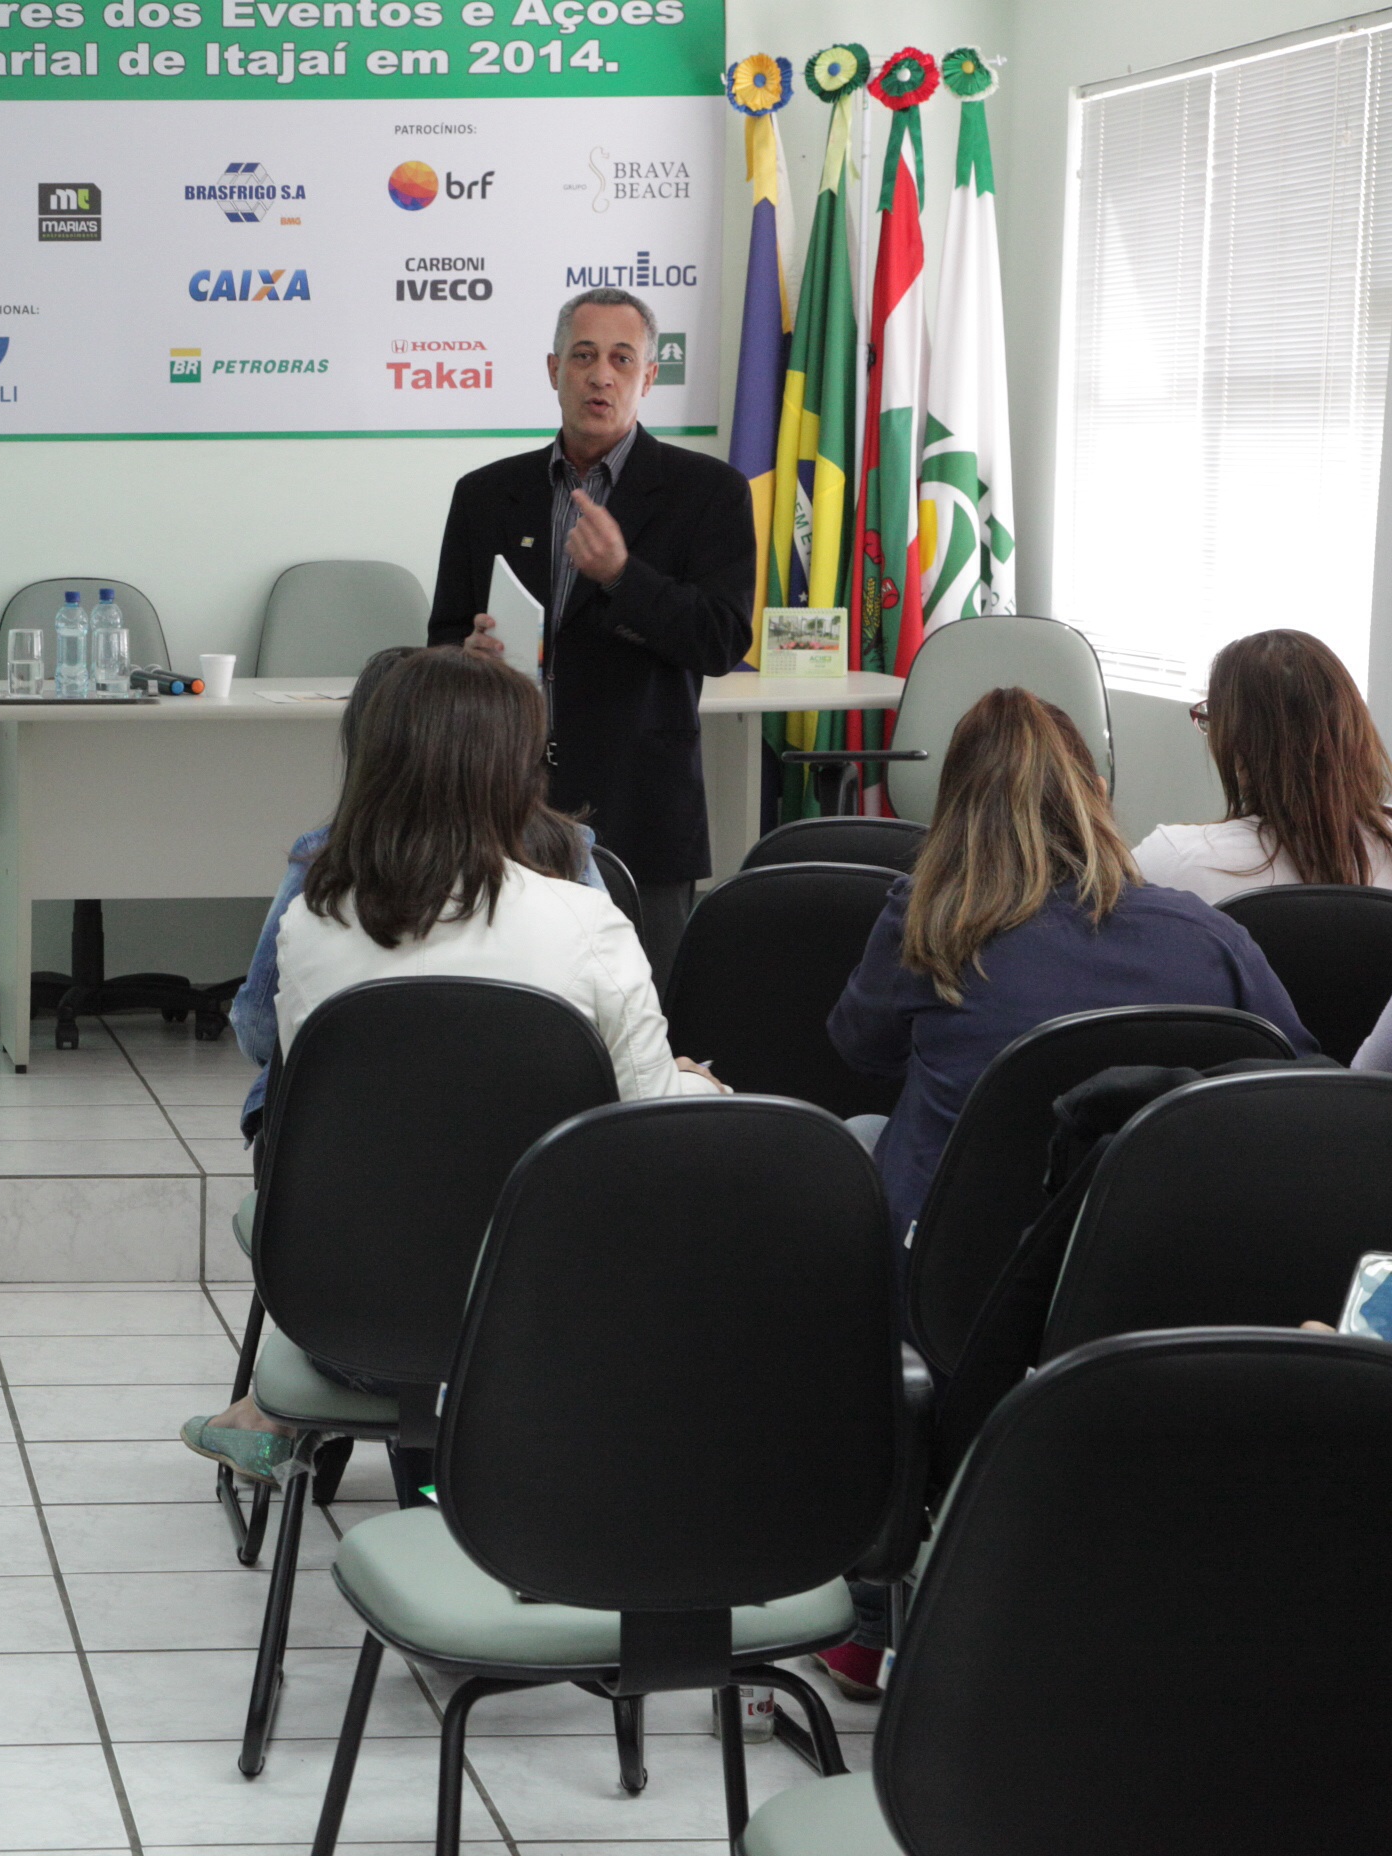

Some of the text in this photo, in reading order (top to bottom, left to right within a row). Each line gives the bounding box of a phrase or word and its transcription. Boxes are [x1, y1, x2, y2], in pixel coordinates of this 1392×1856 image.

[103, 0, 202, 28] dos
[222, 0, 443, 28] Eventos
[461, 1, 495, 27] e
[118, 42, 186, 76] de
[206, 41, 350, 84] Itajaí
[366, 49, 449, 75] em
[467, 39, 620, 74] 2014.
[394, 122, 477, 135] PATROCÍNIOS:
[613, 162, 690, 179] BRAVA
[184, 185, 306, 200] BRASFRIGO S.A
[446, 171, 495, 199] brf
[613, 181, 690, 199] BEACH
[405, 257, 485, 272] CARBONI
[188, 269, 311, 302] CAIXA
[395, 278, 493, 301] IVECO
[411, 340, 487, 351] HONDA
[172, 360, 199, 374] BR
[212, 359, 329, 374] PETROBRAS
[386, 361, 493, 389] Takai
